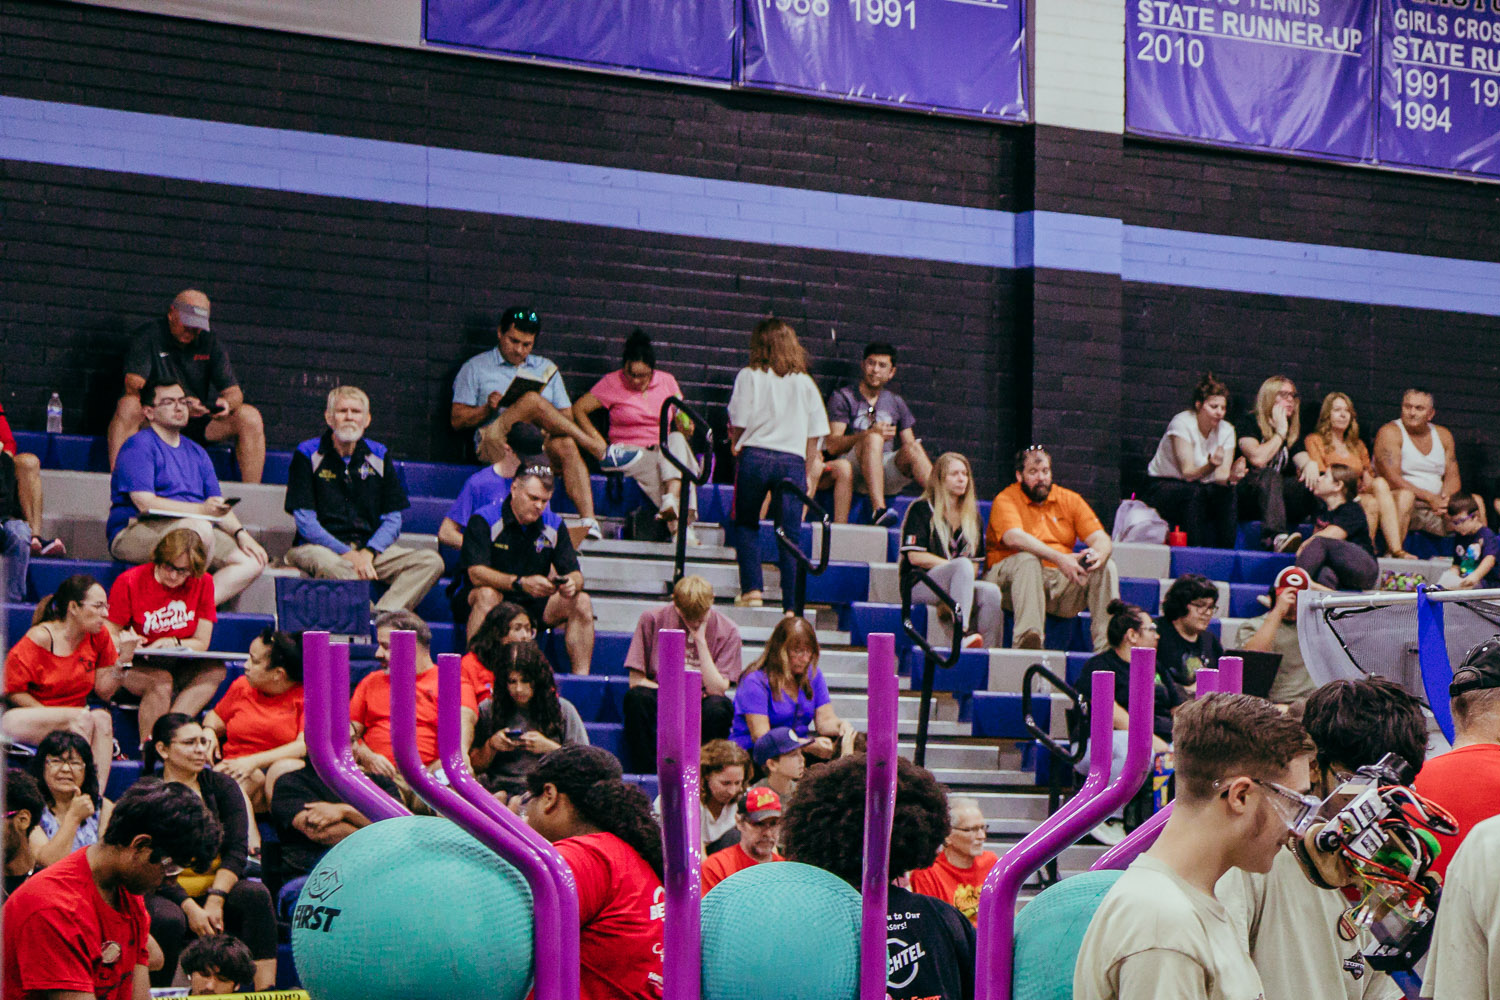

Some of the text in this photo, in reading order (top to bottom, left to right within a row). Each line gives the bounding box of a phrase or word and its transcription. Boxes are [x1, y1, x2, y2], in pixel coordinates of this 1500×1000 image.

[850, 0, 917, 30] 1991
[1137, 0, 1363, 52] STATE RUNNER-UP
[1394, 8, 1448, 36] GIRLS
[1137, 32, 1205, 68] 2010
[1393, 36, 1465, 67] STATE
[1392, 67, 1450, 101] 1991
[1391, 101, 1452, 134] 1994
[293, 904, 342, 933] FIRST
[905, 911, 920, 919] Our
[889, 941, 925, 975] CHTEL
